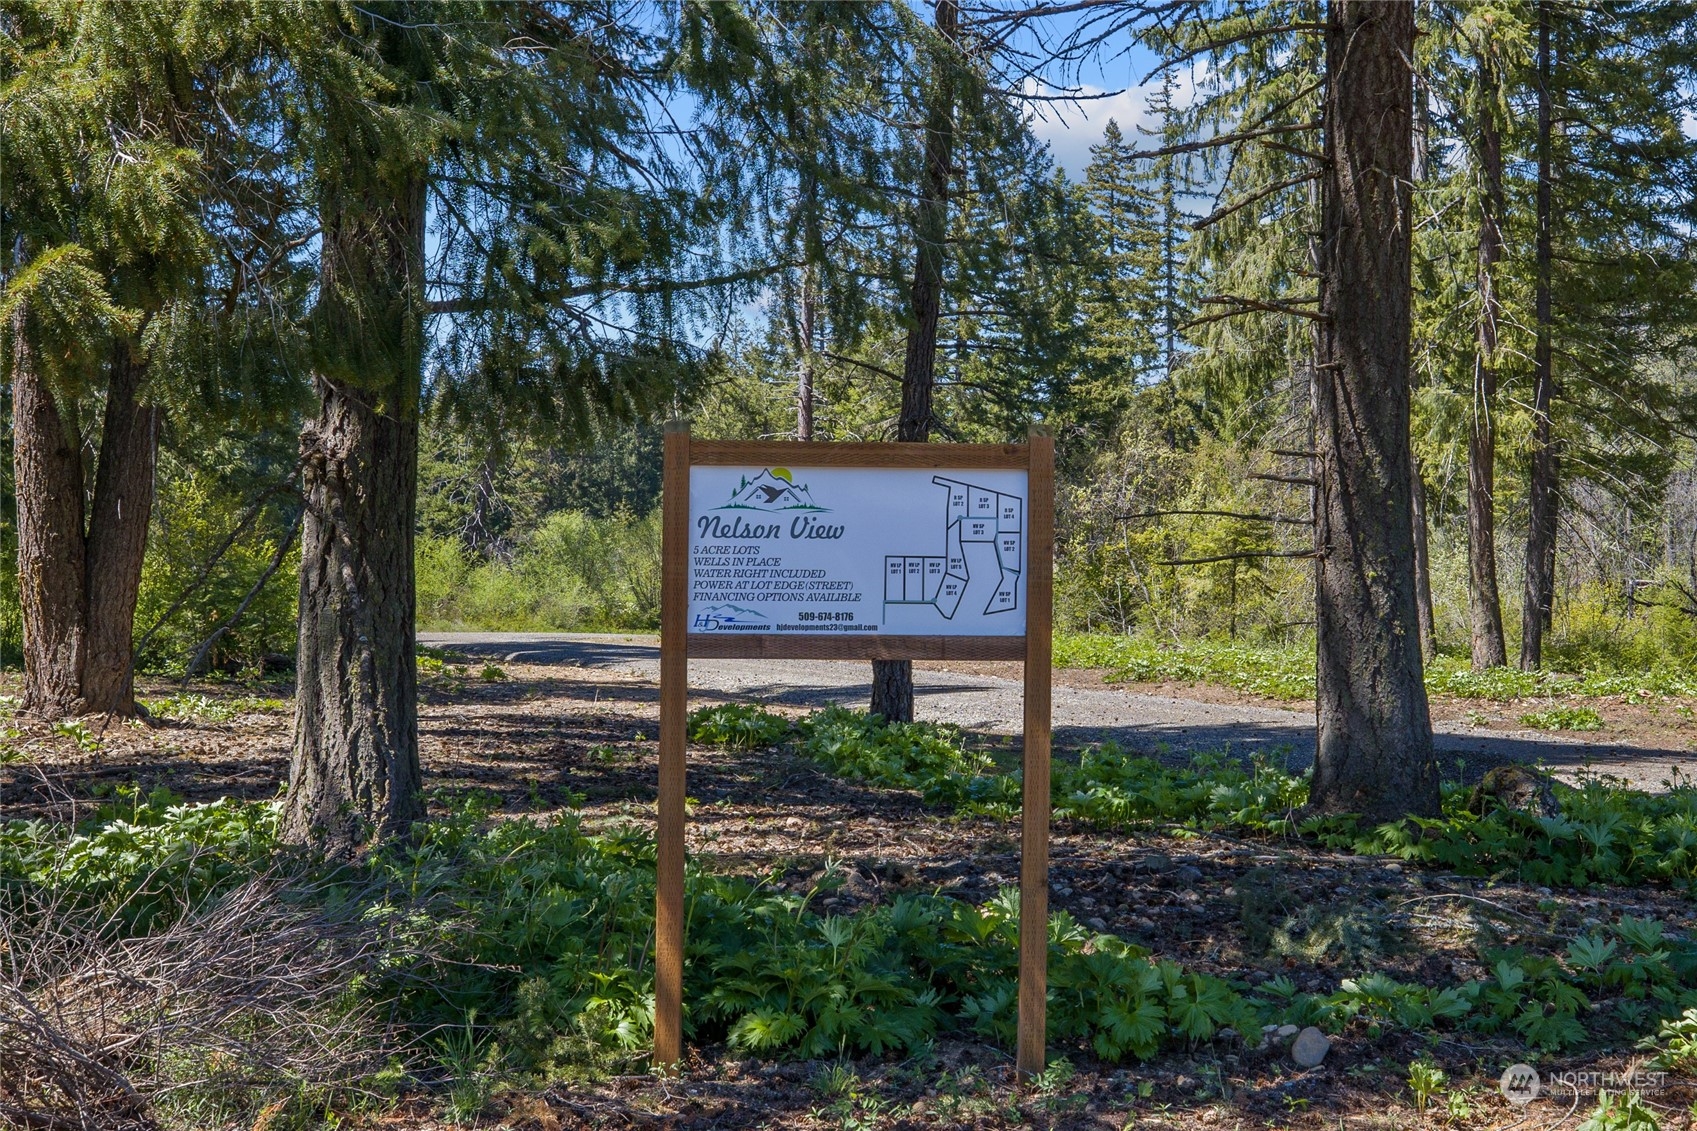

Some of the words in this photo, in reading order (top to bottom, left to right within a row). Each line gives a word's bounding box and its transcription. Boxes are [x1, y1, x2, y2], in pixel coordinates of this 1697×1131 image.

[698, 516, 780, 539] Nelson
[790, 516, 845, 539] View
[694, 546, 699, 554] 5
[701, 546, 731, 554] ACRE
[732, 546, 760, 554] LOTS
[694, 558, 730, 566] WELLS
[732, 558, 744, 566] IN
[745, 558, 781, 566] PLACE
[694, 569, 733, 578] WATER
[734, 569, 767, 578] RIGHT
[770, 569, 826, 578] INCLUDED
[694, 581, 736, 590] POWER
[736, 581, 750, 590] AT
[751, 581, 772, 590] LOT
[693, 593, 755, 601] FINANCING
[757, 593, 804, 602] OPTIONS
[798, 612, 854, 621] 509-674-8176
